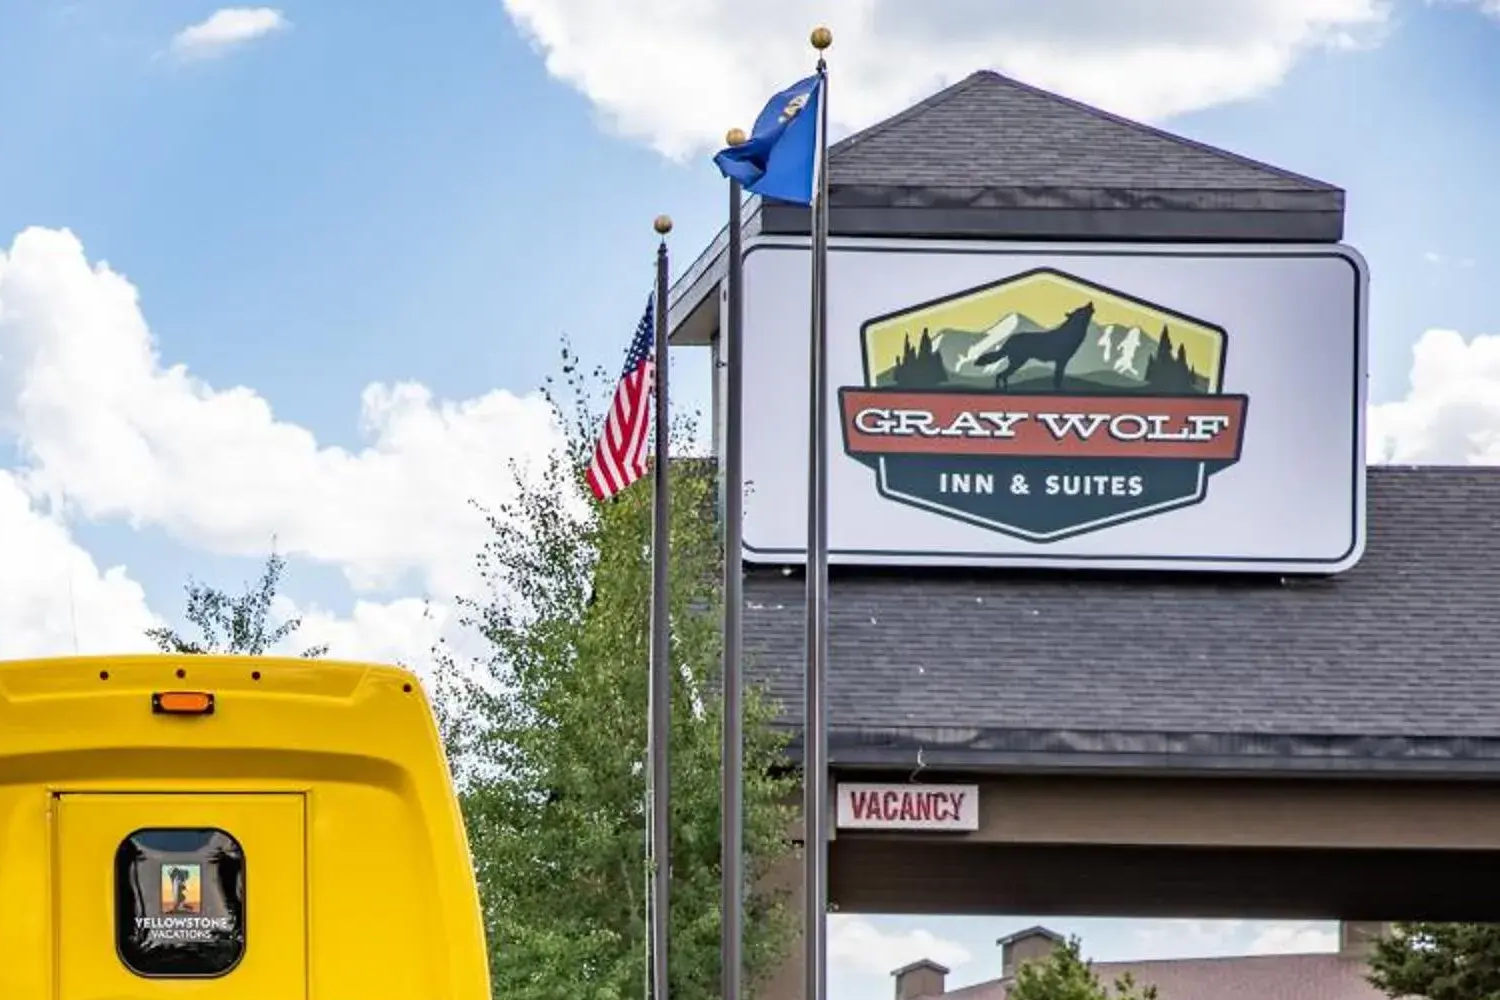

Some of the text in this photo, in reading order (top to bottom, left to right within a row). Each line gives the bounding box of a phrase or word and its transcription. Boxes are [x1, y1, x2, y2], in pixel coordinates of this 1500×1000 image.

[853, 408, 1230, 443] GRAY WOLF
[939, 472, 1144, 497] INN & SUITES
[850, 790, 966, 822] VACANCY
[134, 916, 228, 929] YELLOWSTONE
[151, 929, 212, 940] VACATIONS
